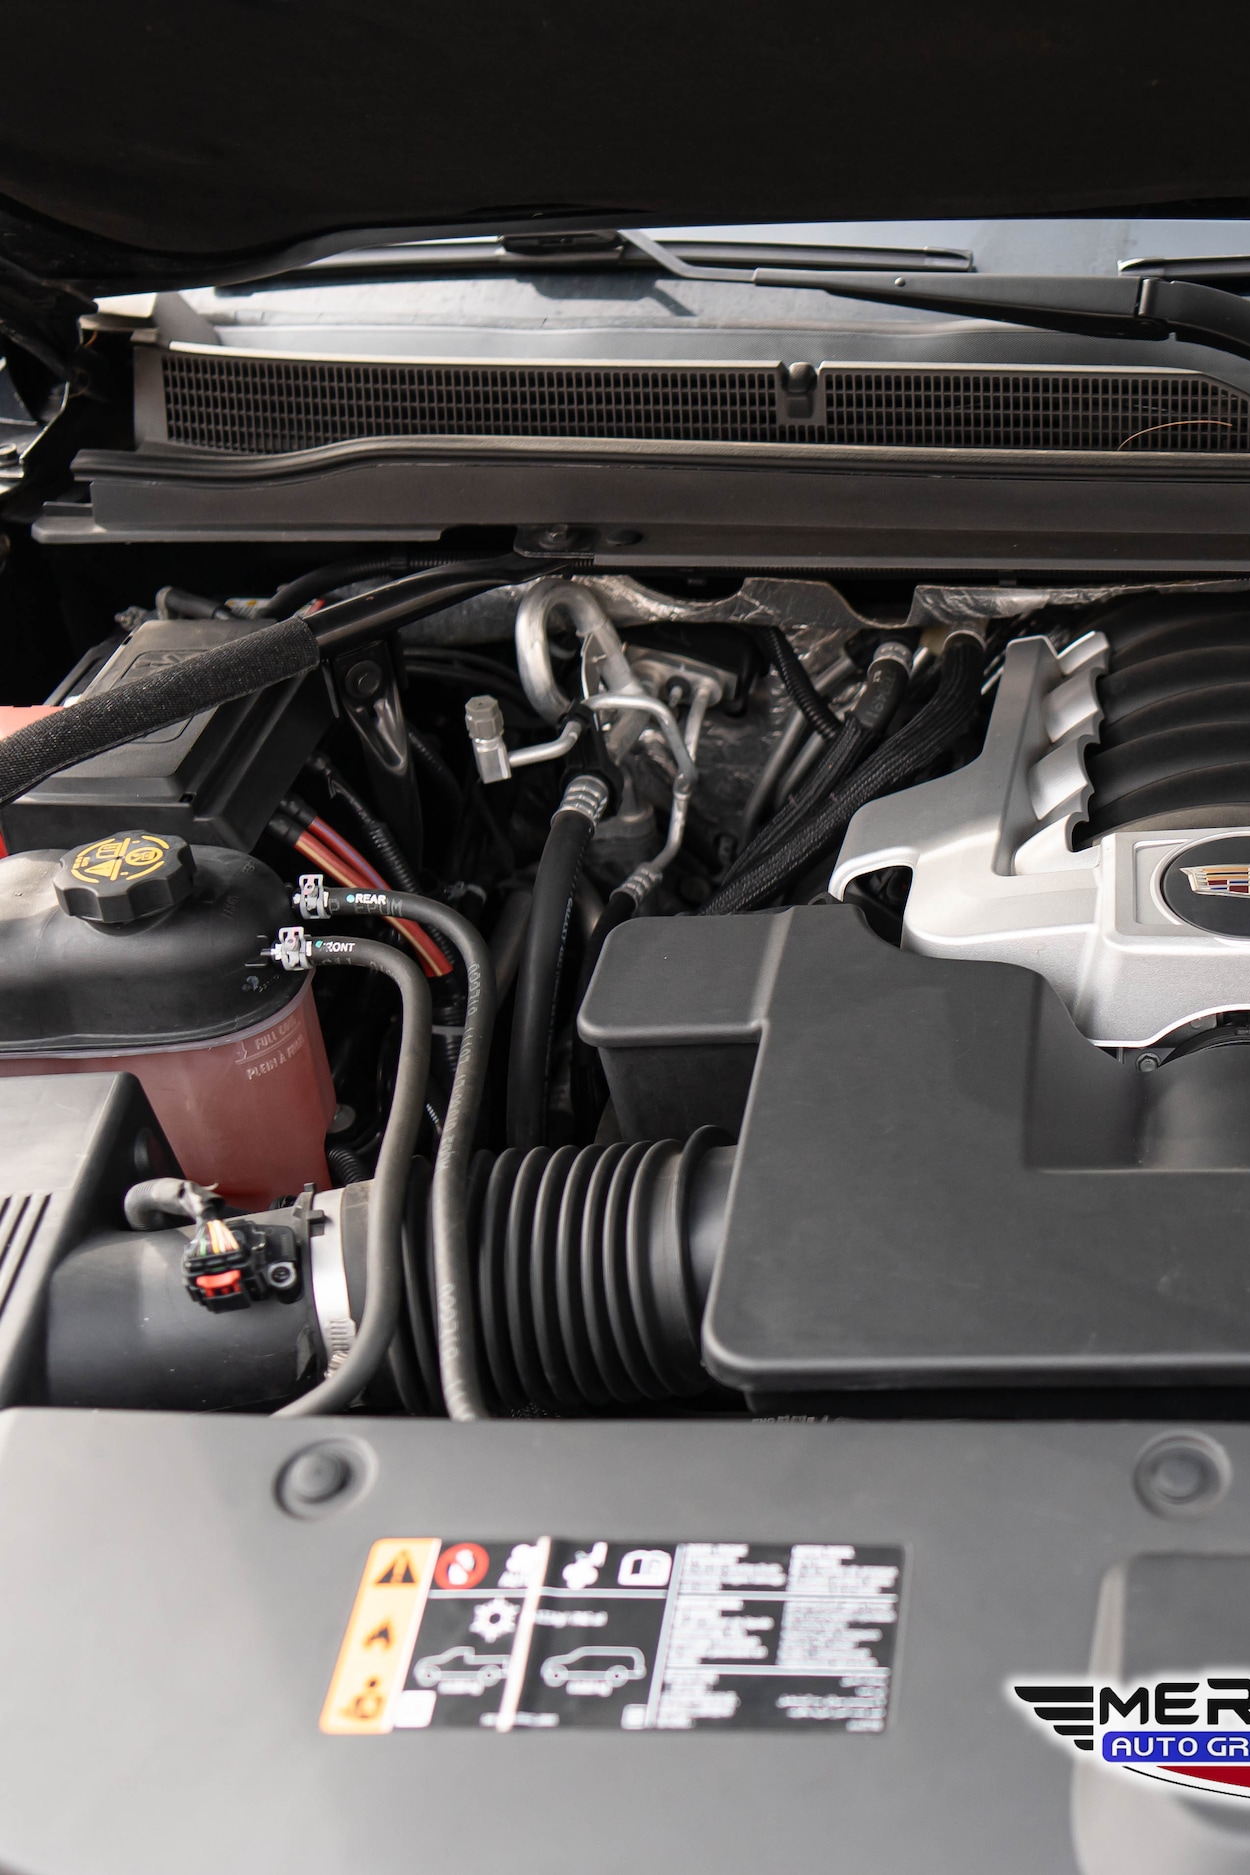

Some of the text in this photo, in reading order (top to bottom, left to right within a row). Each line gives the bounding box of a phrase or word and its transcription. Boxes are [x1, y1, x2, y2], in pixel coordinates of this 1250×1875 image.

[355, 893, 387, 905] REAR
[323, 941, 356, 952] RONT
[255, 1031, 277, 1050] FULL
[246, 1057, 278, 1080] PLEIN
